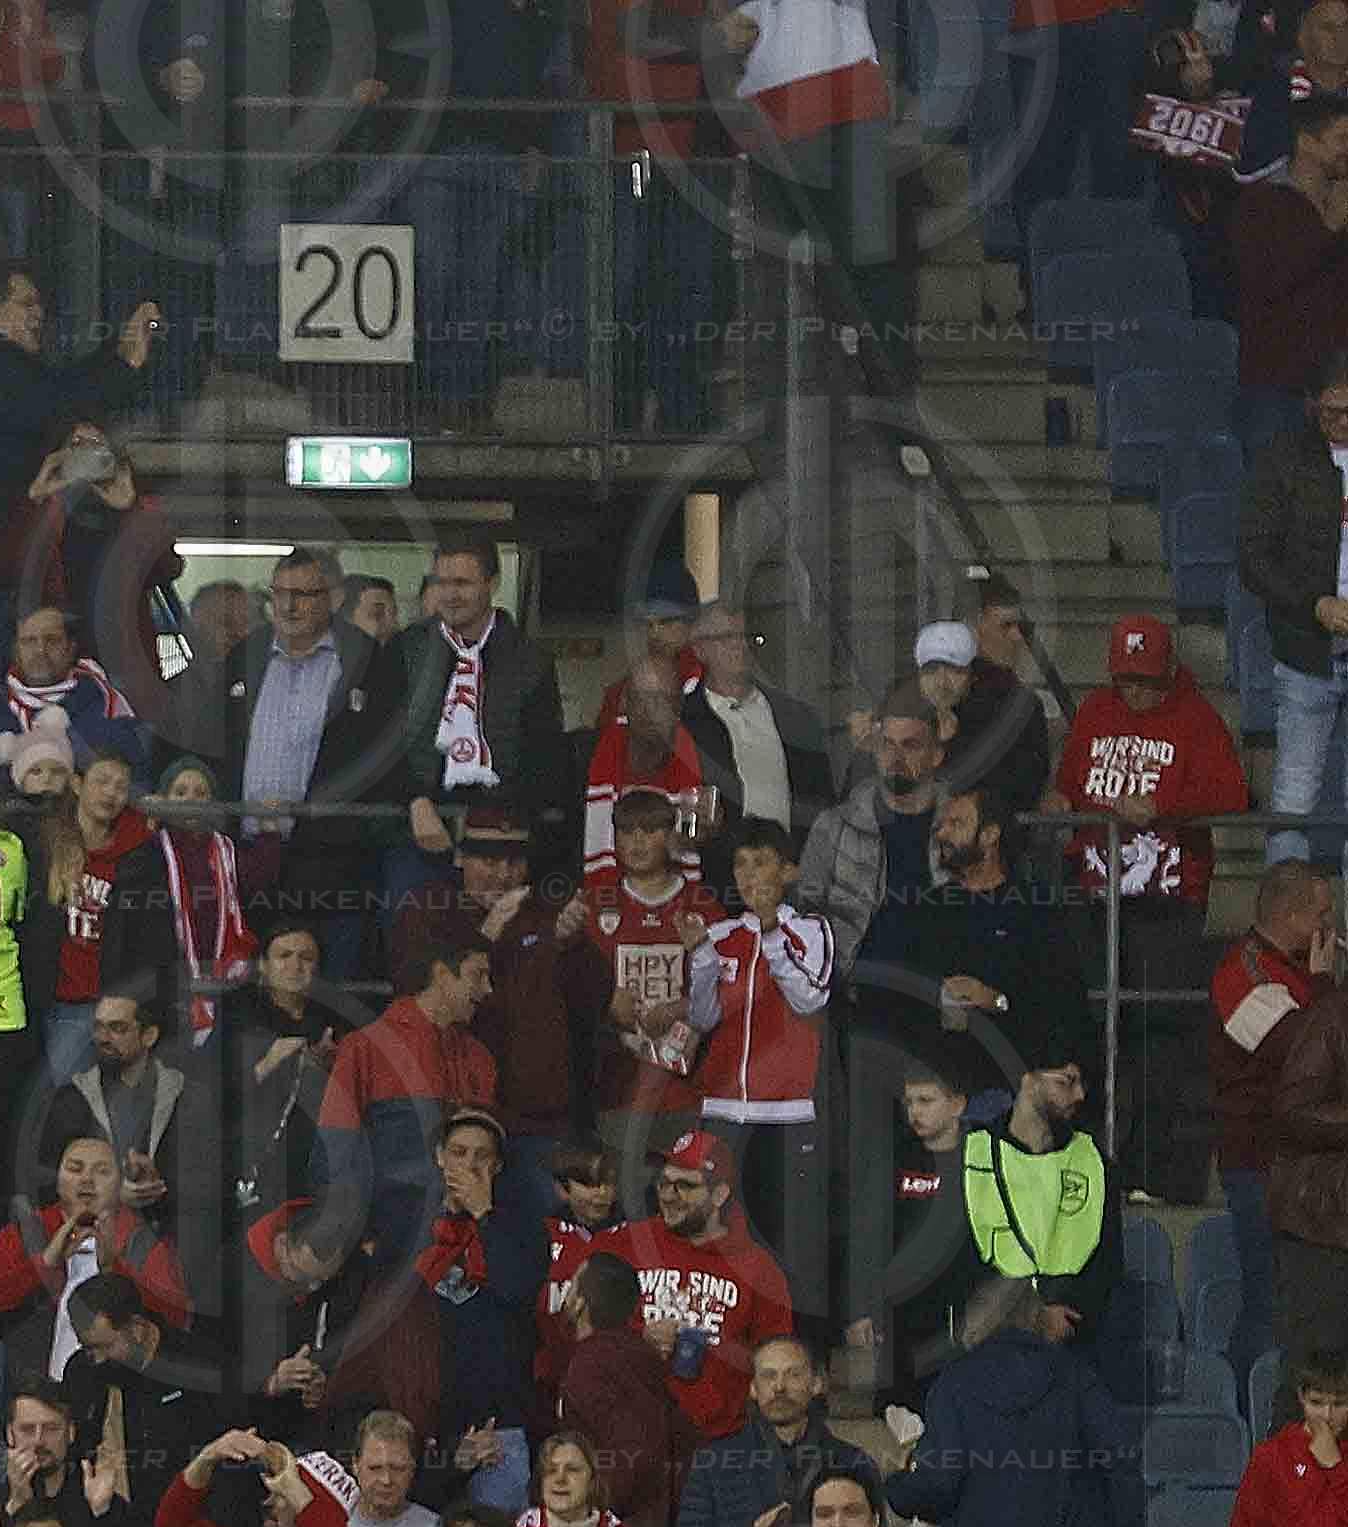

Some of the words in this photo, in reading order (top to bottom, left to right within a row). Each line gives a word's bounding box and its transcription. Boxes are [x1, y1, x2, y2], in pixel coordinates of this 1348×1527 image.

[292, 245, 403, 340] 20
[637, 1269, 680, 1296] WIR
[688, 1271, 738, 1307] SIND
